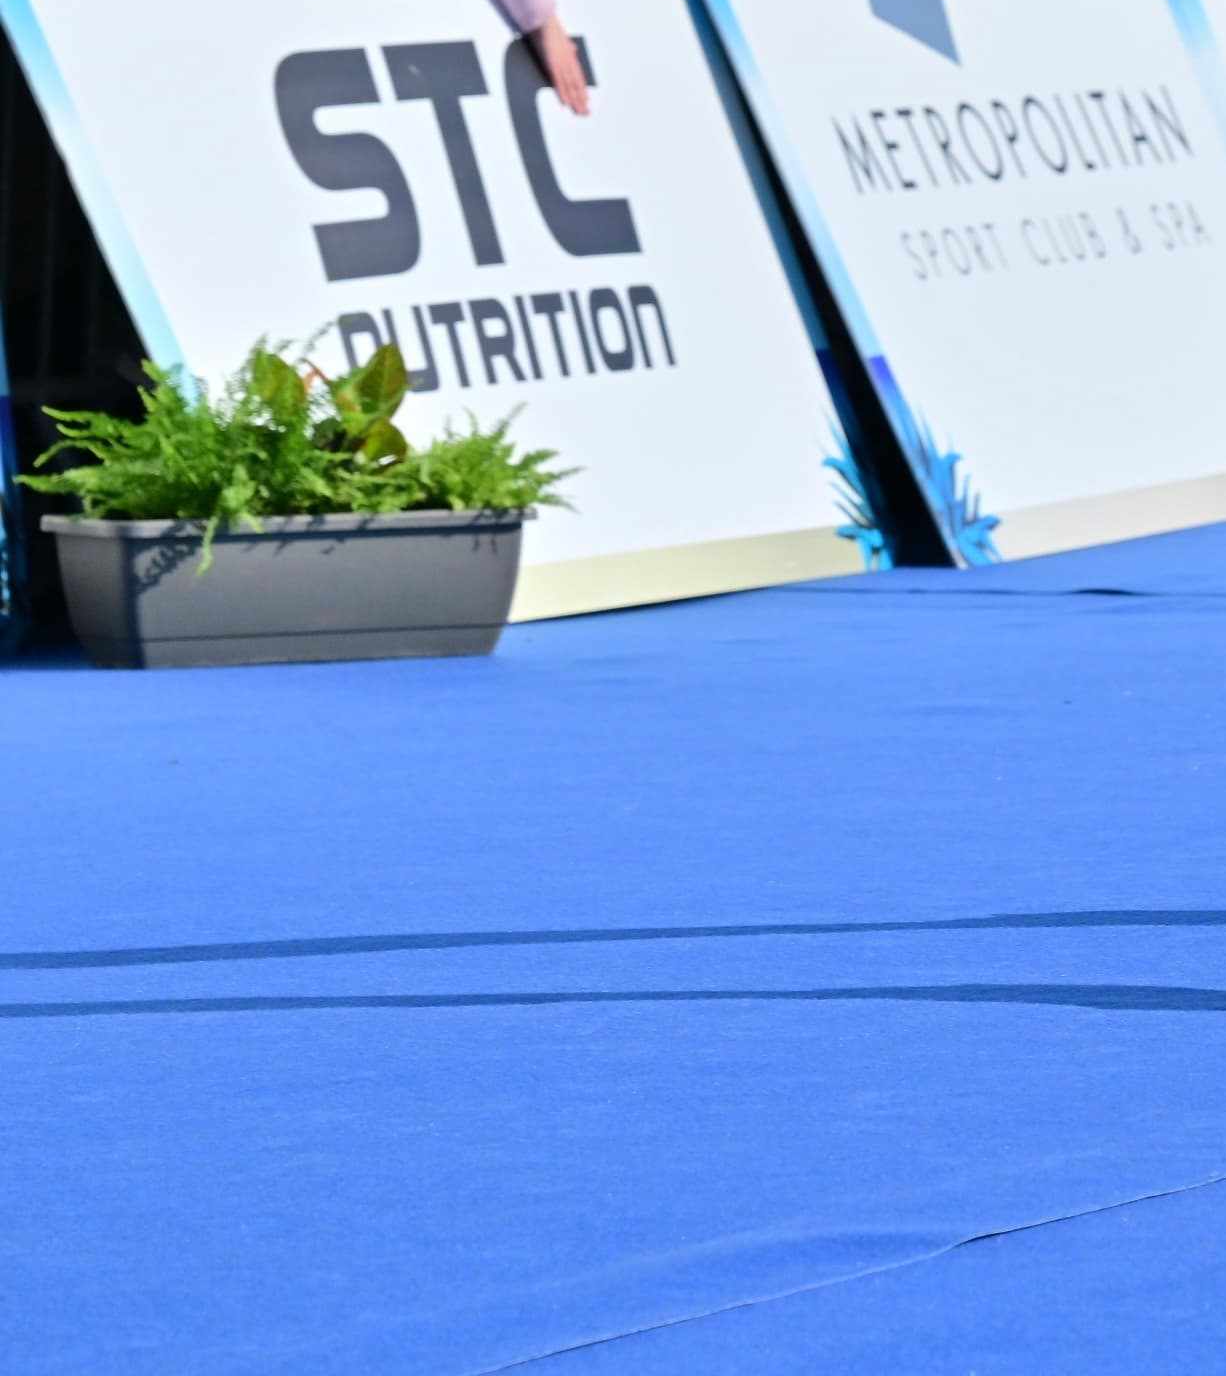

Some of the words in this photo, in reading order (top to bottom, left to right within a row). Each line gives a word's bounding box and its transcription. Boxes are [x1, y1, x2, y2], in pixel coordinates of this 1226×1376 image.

[274, 35, 643, 283] STC
[830, 84, 1195, 195] METROPOLITAN
[900, 221, 1010, 281] SPORT
[1019, 211, 1107, 266] CLUB
[1115, 206, 1142, 255] &
[1150, 201, 1213, 252] SPA
